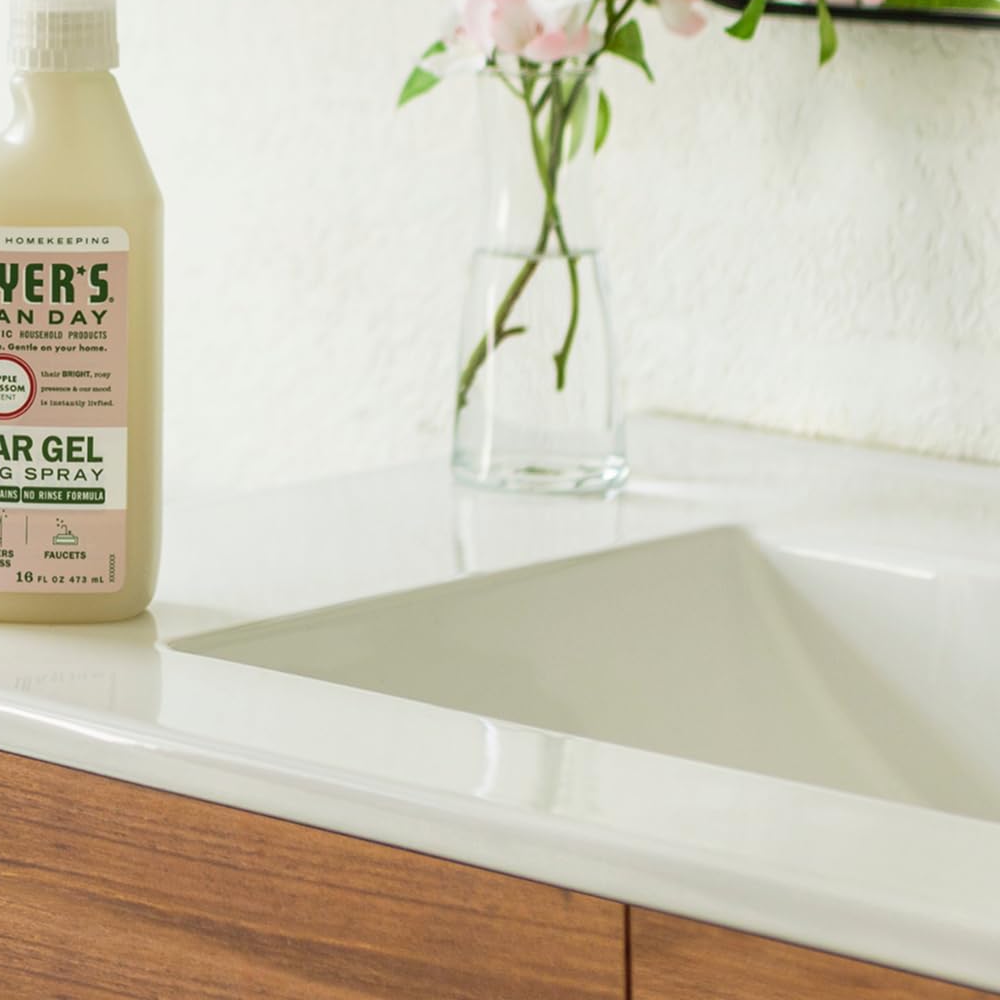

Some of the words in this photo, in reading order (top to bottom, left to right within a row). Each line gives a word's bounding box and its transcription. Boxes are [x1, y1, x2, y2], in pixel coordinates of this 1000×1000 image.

[49, 310, 107, 325] DAY
[20, 331, 62, 339] HOUSEHOLD
[68, 331, 107, 339] PRODUCTS
[8, 343, 38, 351] Gentle
[55, 345, 76, 353] your
[79, 344, 107, 352] home.
[62, 371, 92, 379] BRIGHT,
[50, 400, 85, 408] instantly
[42, 435, 103, 463] GEL
[24, 467, 104, 481] SPRAY
[23, 490, 35, 499] NO
[39, 490, 62, 500] RINSE
[66, 491, 104, 500] FORMULA
[44, 551, 86, 559] FAUCETS
[16, 571, 34, 582] 16
